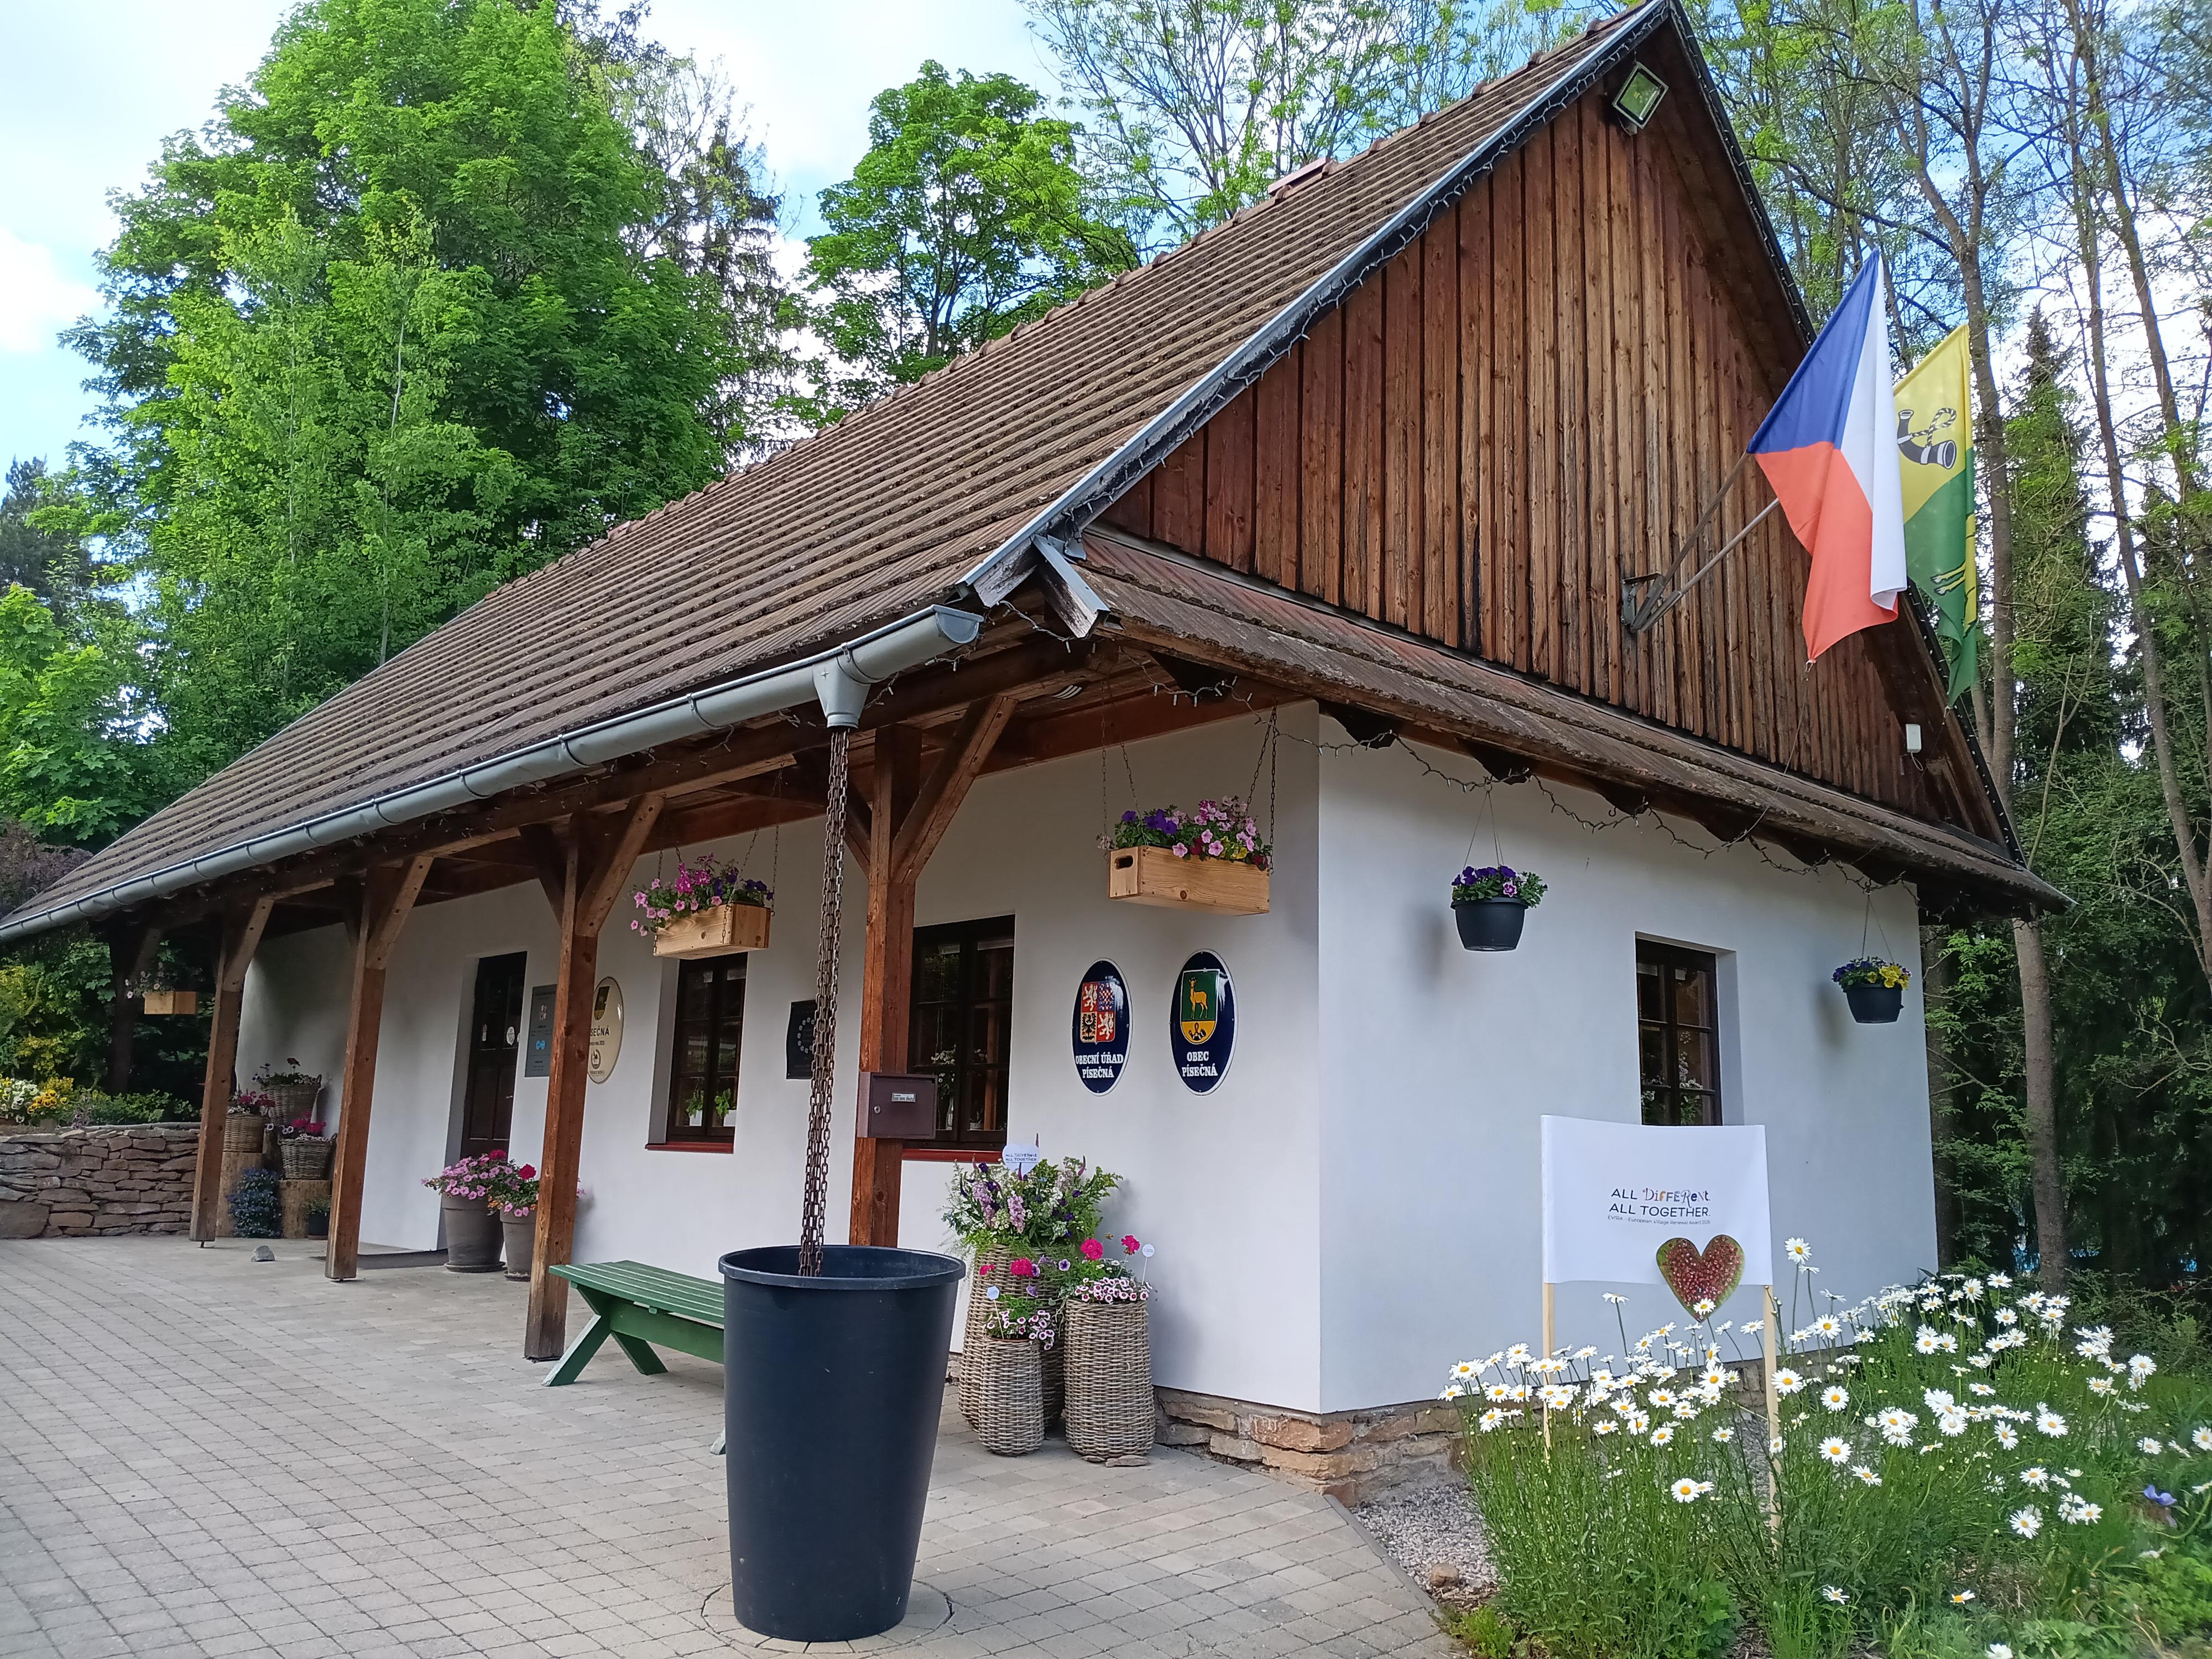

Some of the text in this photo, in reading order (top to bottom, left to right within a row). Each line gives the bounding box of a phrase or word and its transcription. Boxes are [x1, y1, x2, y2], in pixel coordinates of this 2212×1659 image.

[590, 1025, 609, 1036] SEČNÁ
[1076, 1051, 1124, 1065] OBECNÍ ÚŘAD
[1187, 1051, 1209, 1062] OBEC
[1082, 1066, 1115, 1078] PÍSEČNÁ
[1181, 1063, 1218, 1077] PÍSEČNÁ
[1611, 1188, 1637, 1200] ALL
[1609, 1203, 1711, 1217] ALL TOGETHER.
